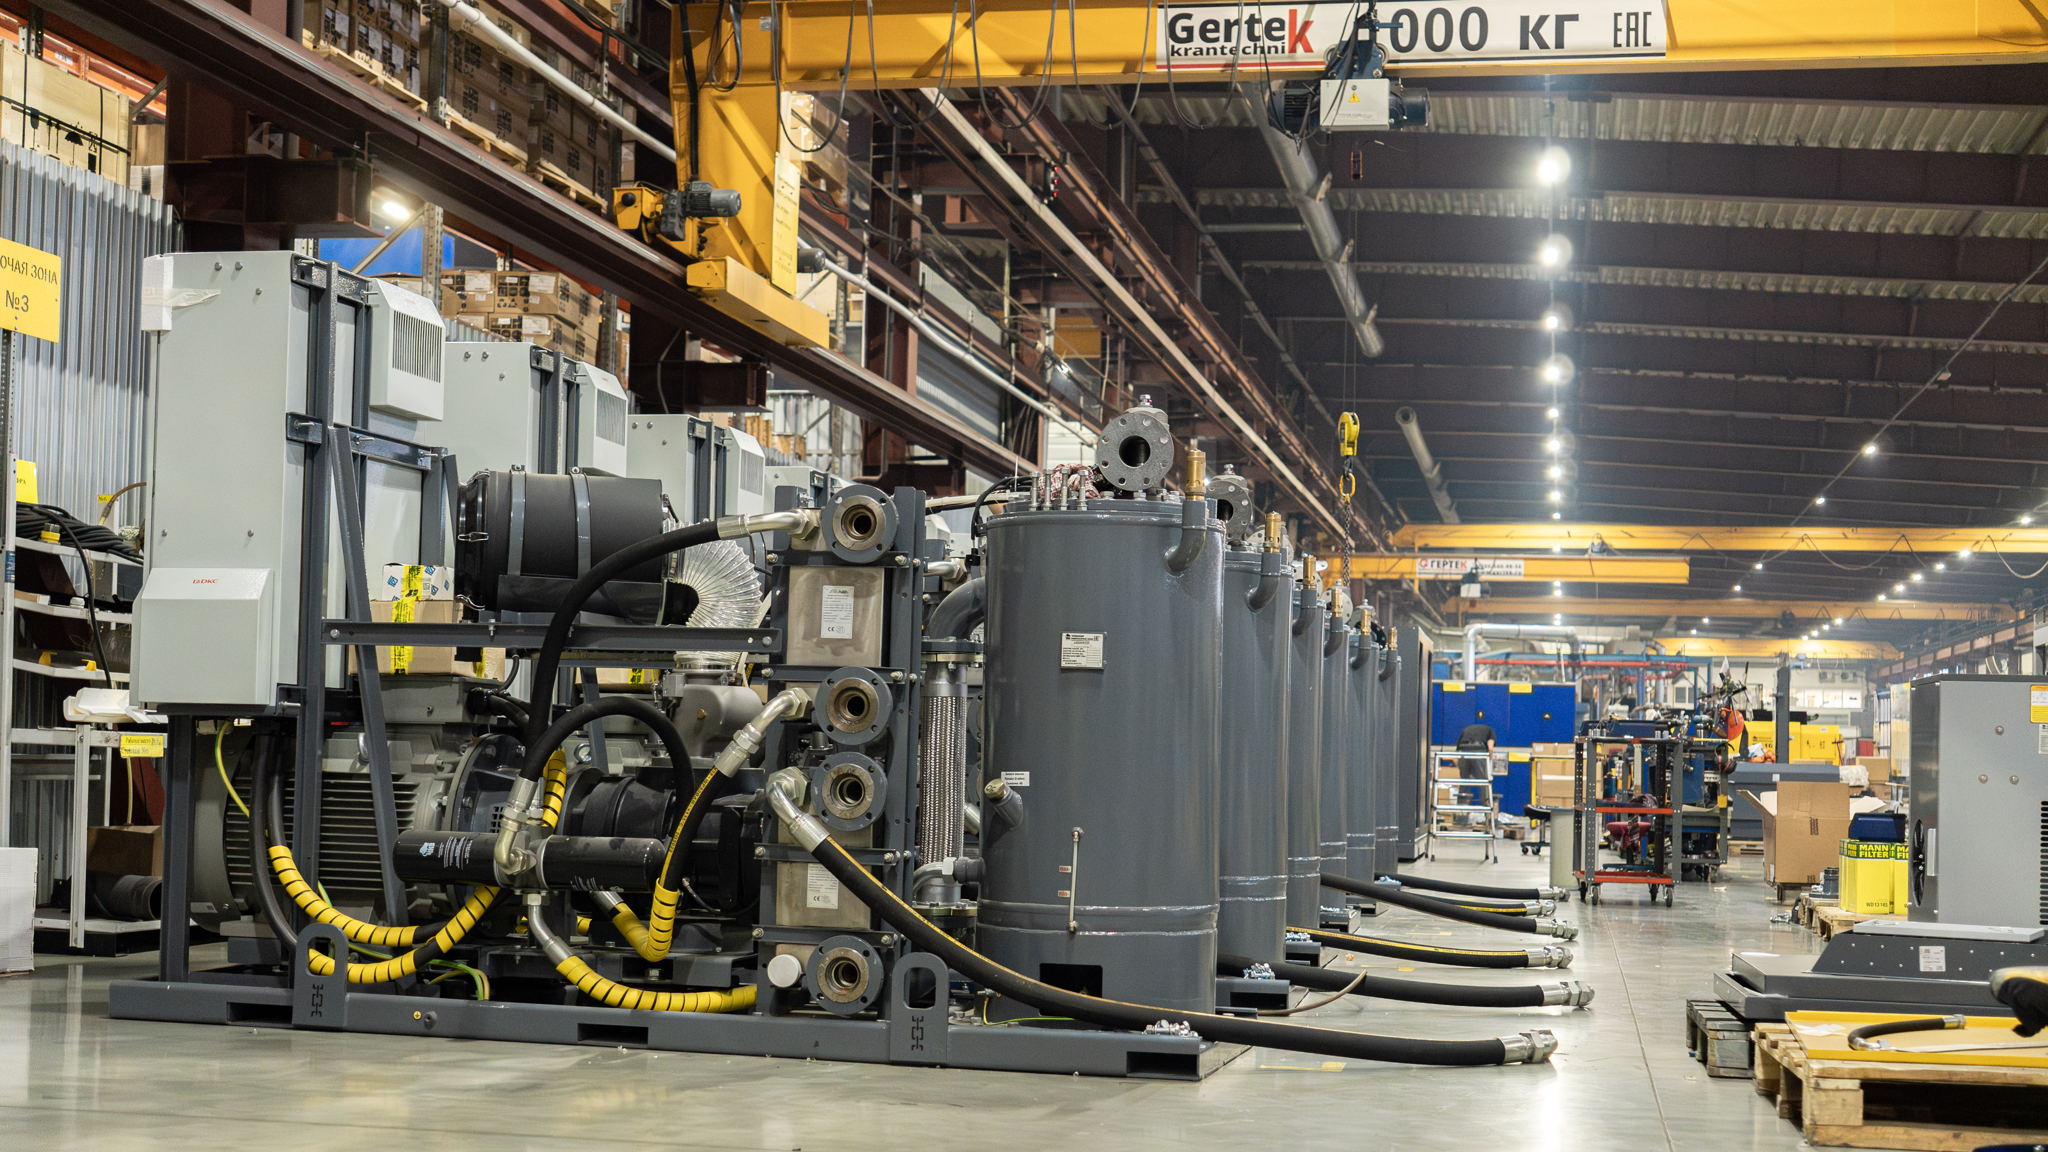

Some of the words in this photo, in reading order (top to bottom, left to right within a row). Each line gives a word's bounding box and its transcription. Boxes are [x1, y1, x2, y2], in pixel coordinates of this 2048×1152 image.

[1168, 9, 1314, 54] Gertek
[1390, 6, 1489, 54] 000
[31, 264, 58, 286] ЗОНА
[6, 290, 29, 312] №3
[1430, 560, 1467, 569] ГЕРТЕК
[1859, 844, 1889, 852] MANN
